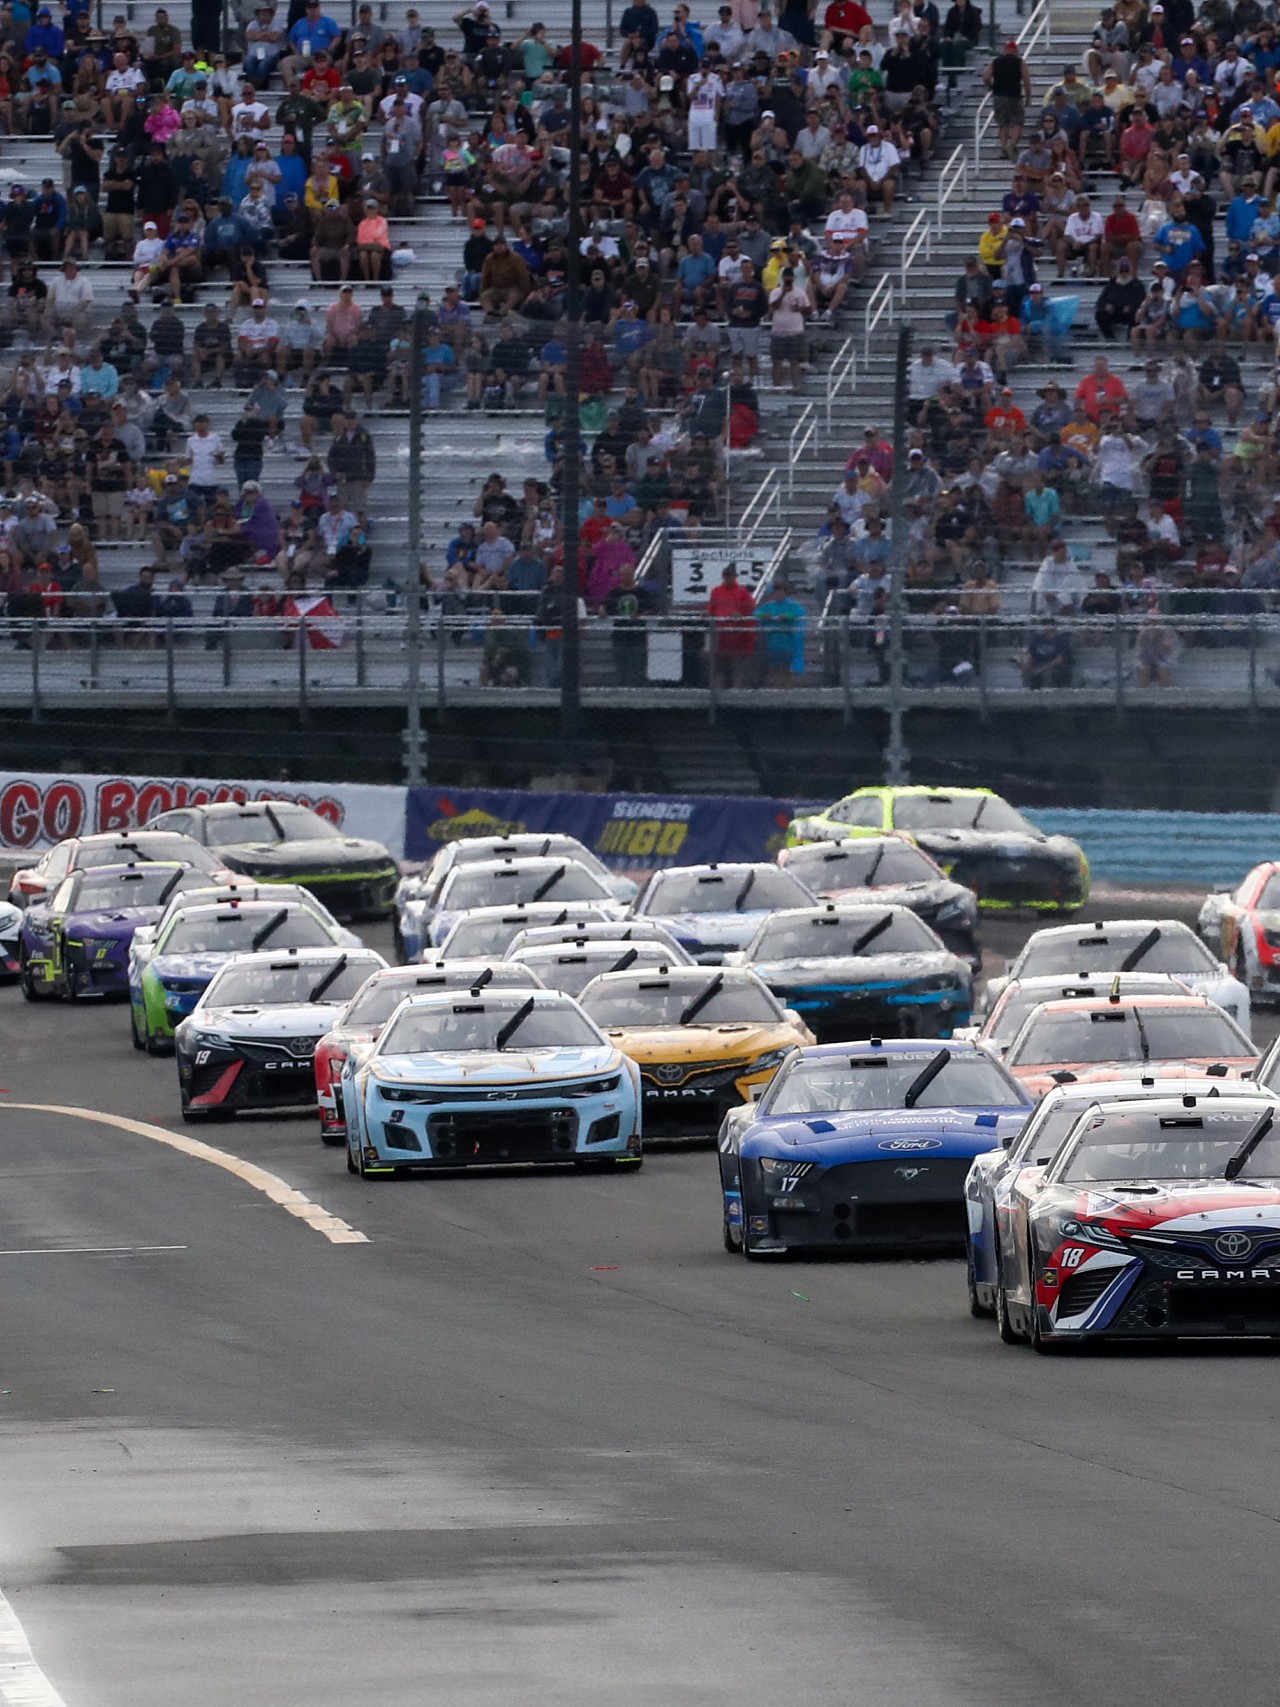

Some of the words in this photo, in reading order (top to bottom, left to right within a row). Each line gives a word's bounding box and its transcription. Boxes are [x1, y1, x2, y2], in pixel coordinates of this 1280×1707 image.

[689, 562, 704, 582] 3
[1, 779, 86, 849] GO
[195, 1050, 211, 1065] 19
[264, 1060, 311, 1071] CAM
[645, 1087, 716, 1098] AMRY
[1207, 1115, 1252, 1123] KYLE
[781, 1177, 800, 1192] 17
[1060, 1248, 1085, 1268] 18
